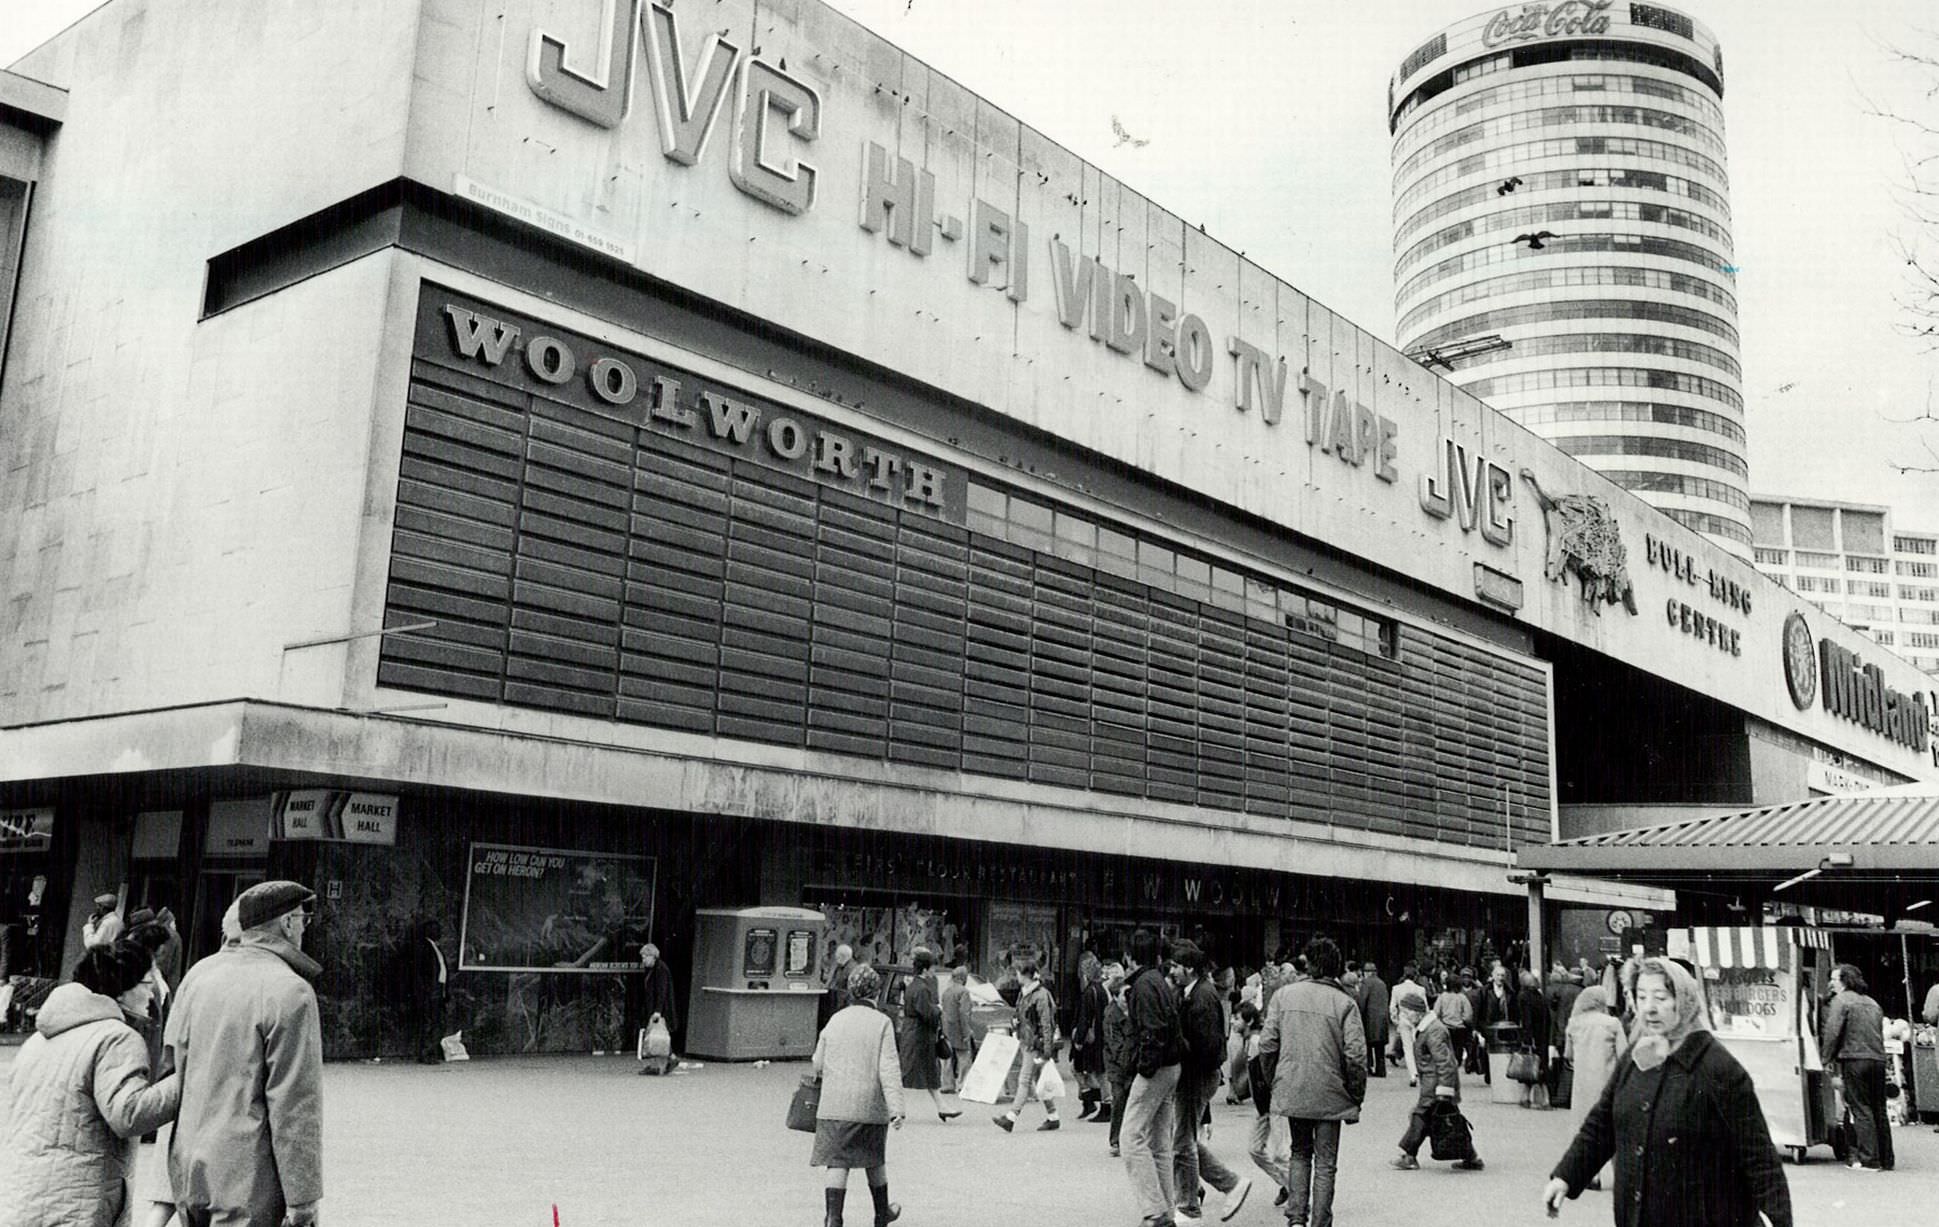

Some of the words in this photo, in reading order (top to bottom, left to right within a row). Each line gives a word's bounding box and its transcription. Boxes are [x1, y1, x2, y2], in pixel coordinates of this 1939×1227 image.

[526, 0, 822, 216] JVC
[468, 183, 531, 218] Burnham
[1050, 234, 1213, 392] VIDEO
[1228, 335, 1287, 425] TV
[1301, 370, 1398, 483] TAPE
[446, 304, 945, 507] WOOLWORTH
[1419, 438, 1514, 547] JVC
[1666, 598, 1742, 657] CENTRE
[1818, 637, 1929, 753] Midland
[290, 800, 316, 811] MARKET
[350, 803, 392, 817] MARKET
[292, 817, 308, 829] HALL
[356, 820, 381, 833] HALL
[474, 862, 493, 874] GET
[492, 863, 508, 875] ON
[485, 851, 508, 863] HOW
[509, 852, 530, 865] LOW
[547, 857, 566, 869] YOU
[1745, 1001, 1777, 1016] DOGS
